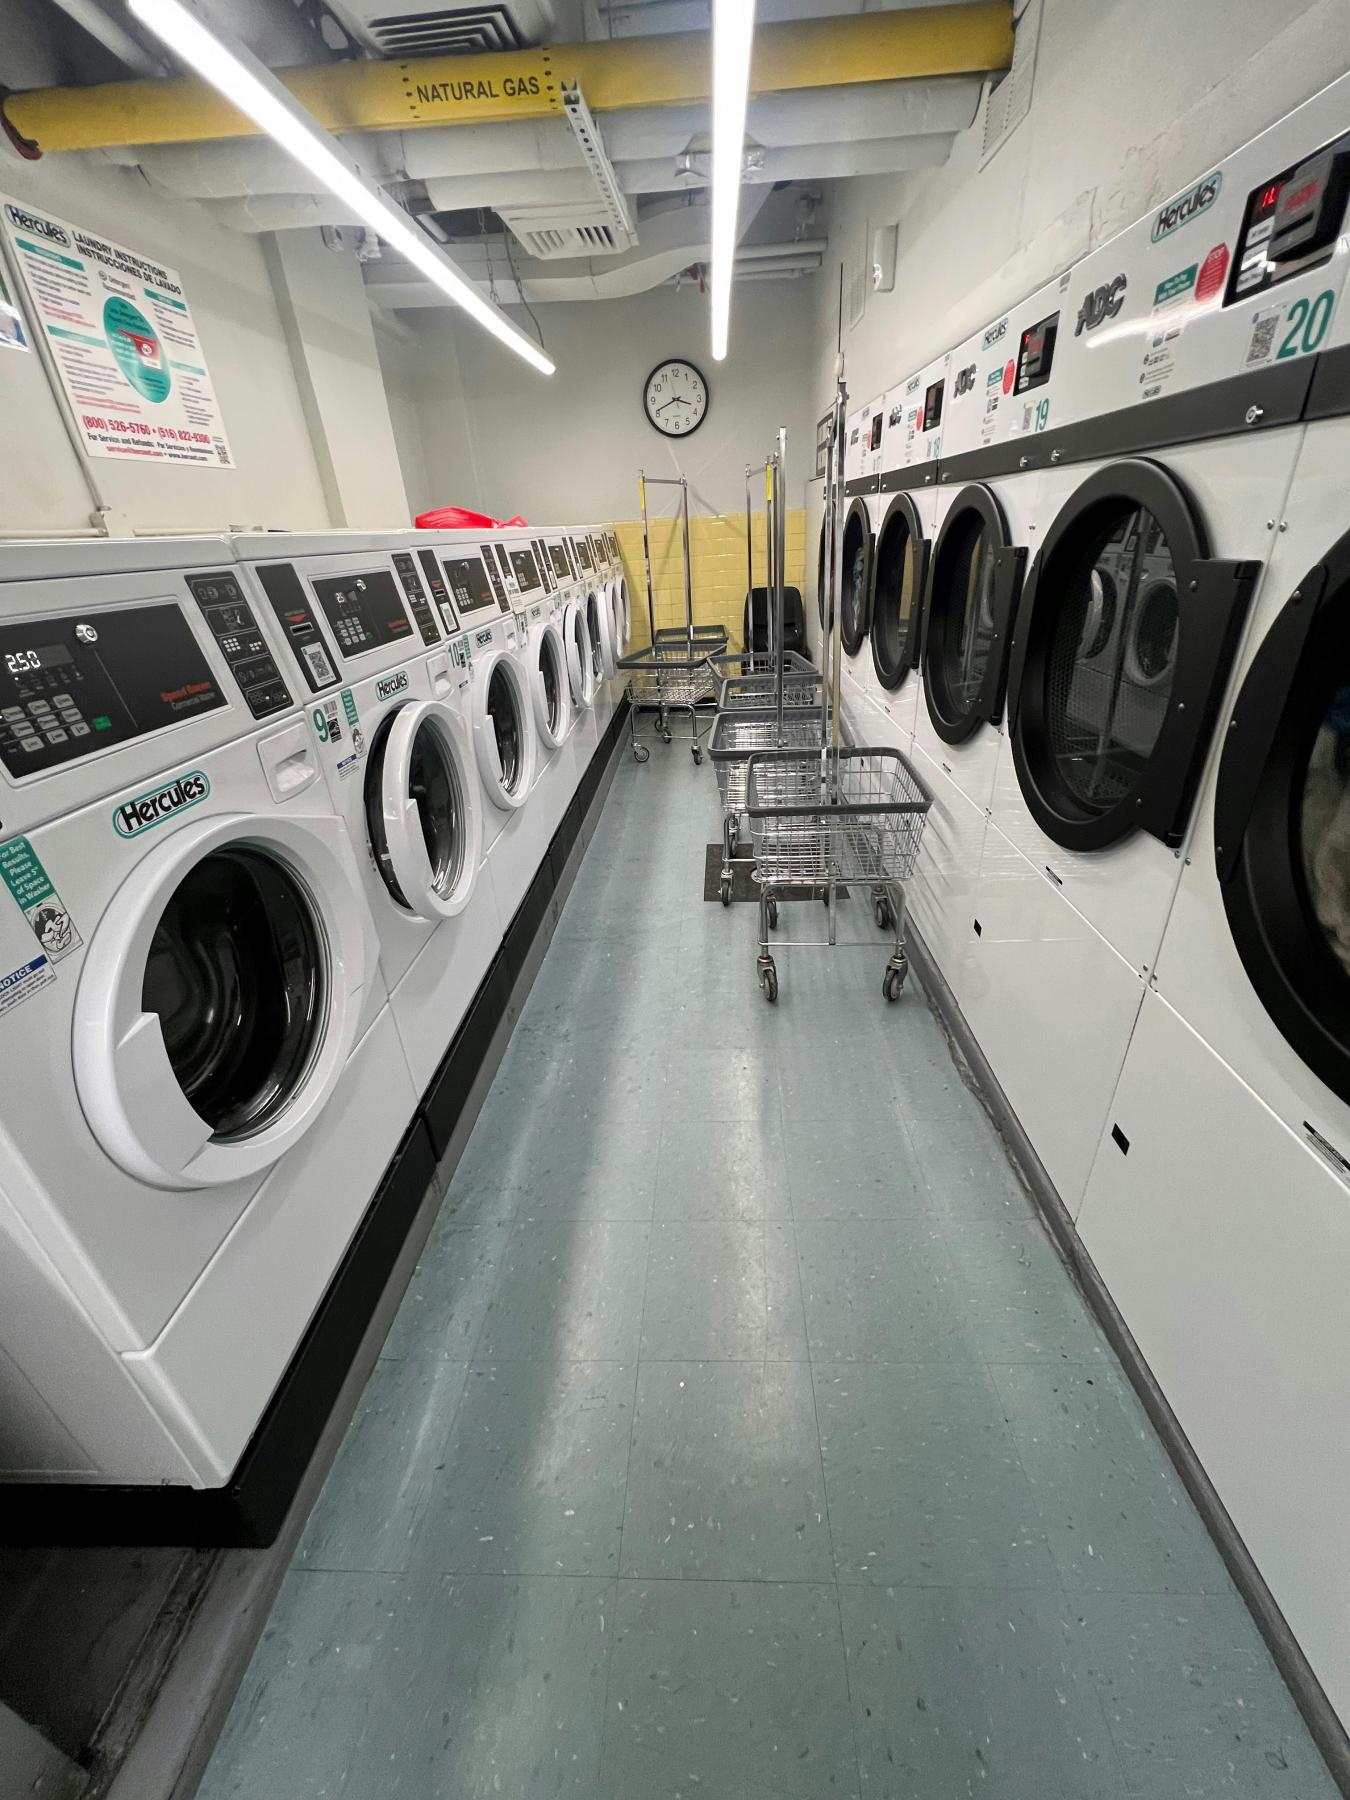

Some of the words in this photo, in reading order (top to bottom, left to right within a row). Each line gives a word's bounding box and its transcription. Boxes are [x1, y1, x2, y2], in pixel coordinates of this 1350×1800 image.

[417, 81, 499, 103] NATURAL
[503, 76, 540, 97] GAS
[1157, 179, 1217, 236] Hercules
[8, 205, 68, 244] Hercules
[72, 230, 113, 256] LAUNDRY
[114, 249, 167, 279] INSTRUCTIONS
[76, 243, 142, 279] INSTRUCCIONES
[143, 271, 154, 284] DE
[155, 277, 181, 295] LAVADO
[1074, 272, 1127, 337] ADC
[1276, 289, 1335, 359] 20
[661, 374, 667, 382] 11
[671, 368, 680, 377] 12
[654, 383, 662, 392] 10
[692, 380, 698, 389] 2
[650, 396, 656, 405] 9
[696, 394, 702, 403] 3
[692, 408, 698, 416] 4
[1034, 398, 1050, 433] 19
[82, 415, 108, 432] (800)
[664, 418, 669, 427] 7
[674, 421, 680, 429] 6
[685, 417, 691, 425] 5
[5, 650, 41, 672] 2.50
[378, 672, 409, 697] Hercules
[312, 708, 329, 743] 9
[119, 775, 205, 832] Hercules
[9, 842, 26, 854] Best
[9, 861, 33, 876] Please
[10, 872, 32, 887] Leave
[16, 885, 25, 895] of
[24, 876, 44, 891] Space
[25, 883, 50, 900] Washer
